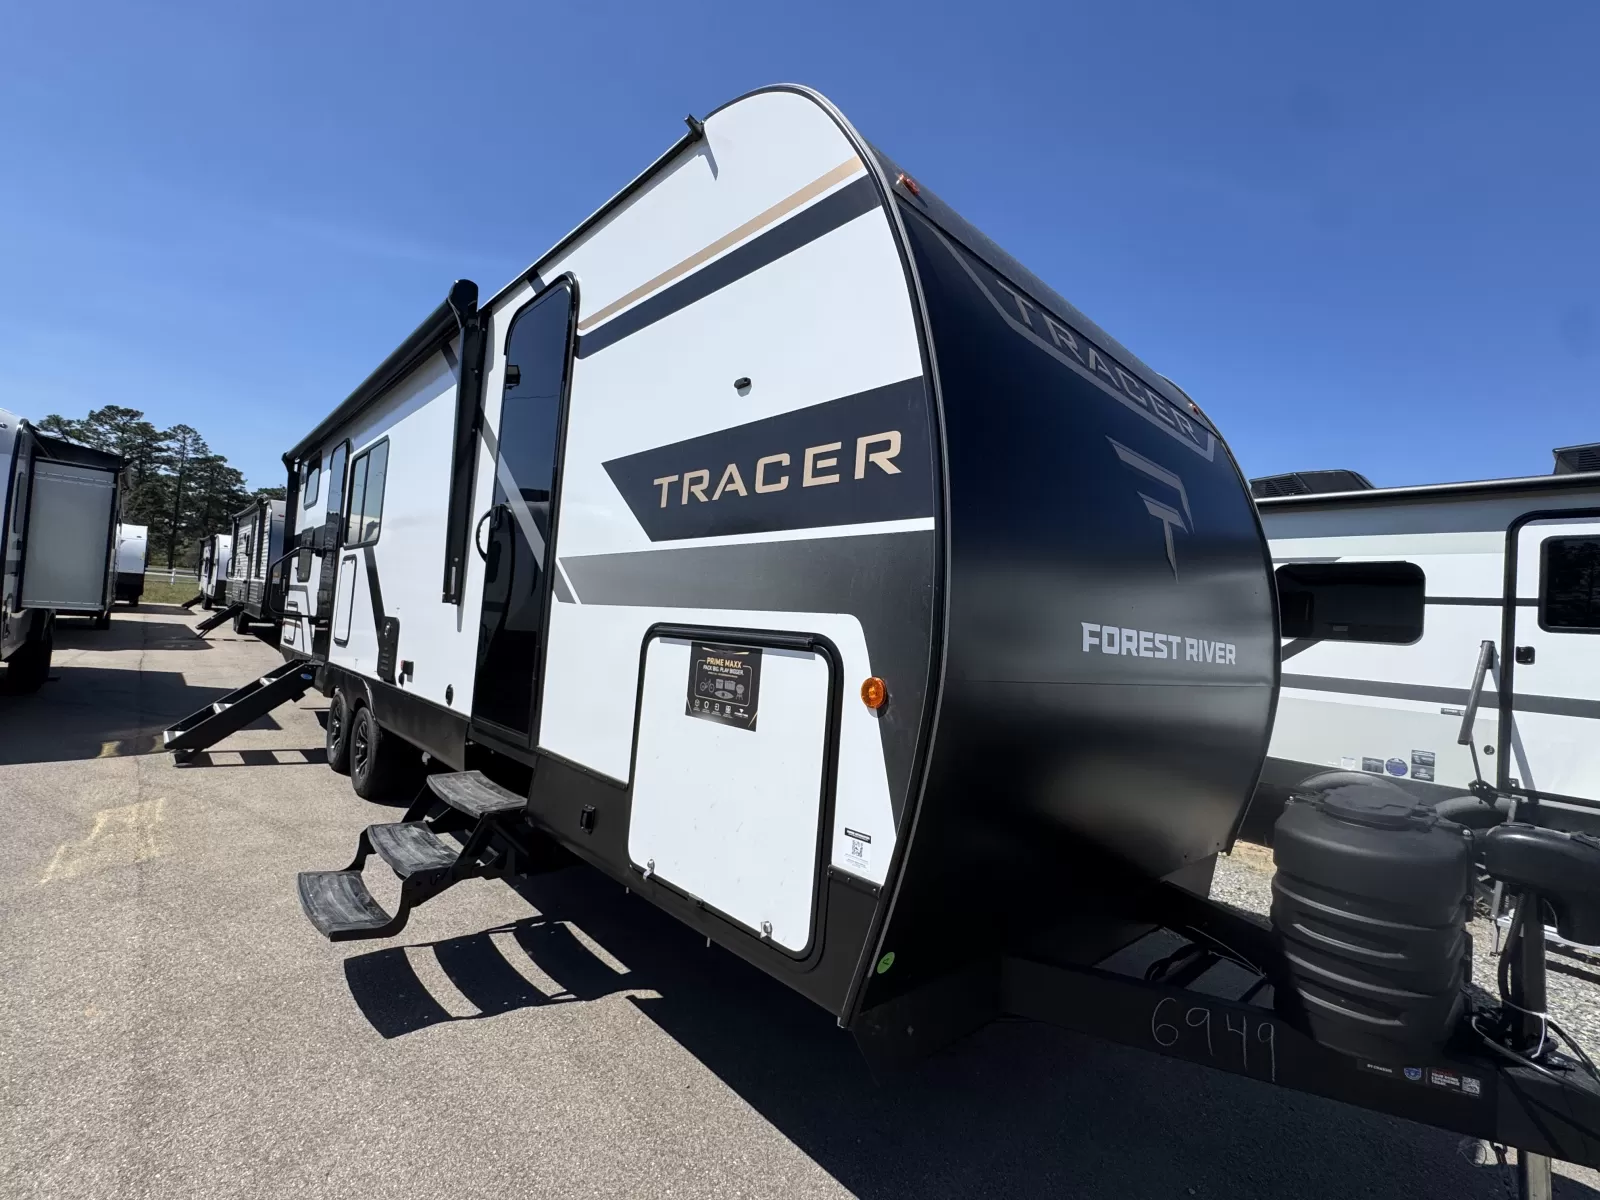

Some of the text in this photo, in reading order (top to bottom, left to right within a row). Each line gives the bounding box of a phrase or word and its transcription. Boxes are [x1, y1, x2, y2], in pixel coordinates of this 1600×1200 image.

[996, 280, 1200, 444] TRACER
[653, 430, 902, 508] TRACER
[706, 657, 742, 669] PRIME MAXX
[1081, 622, 1236, 665] FOREST RIVER
[1152, 997, 1276, 1082] 6949
